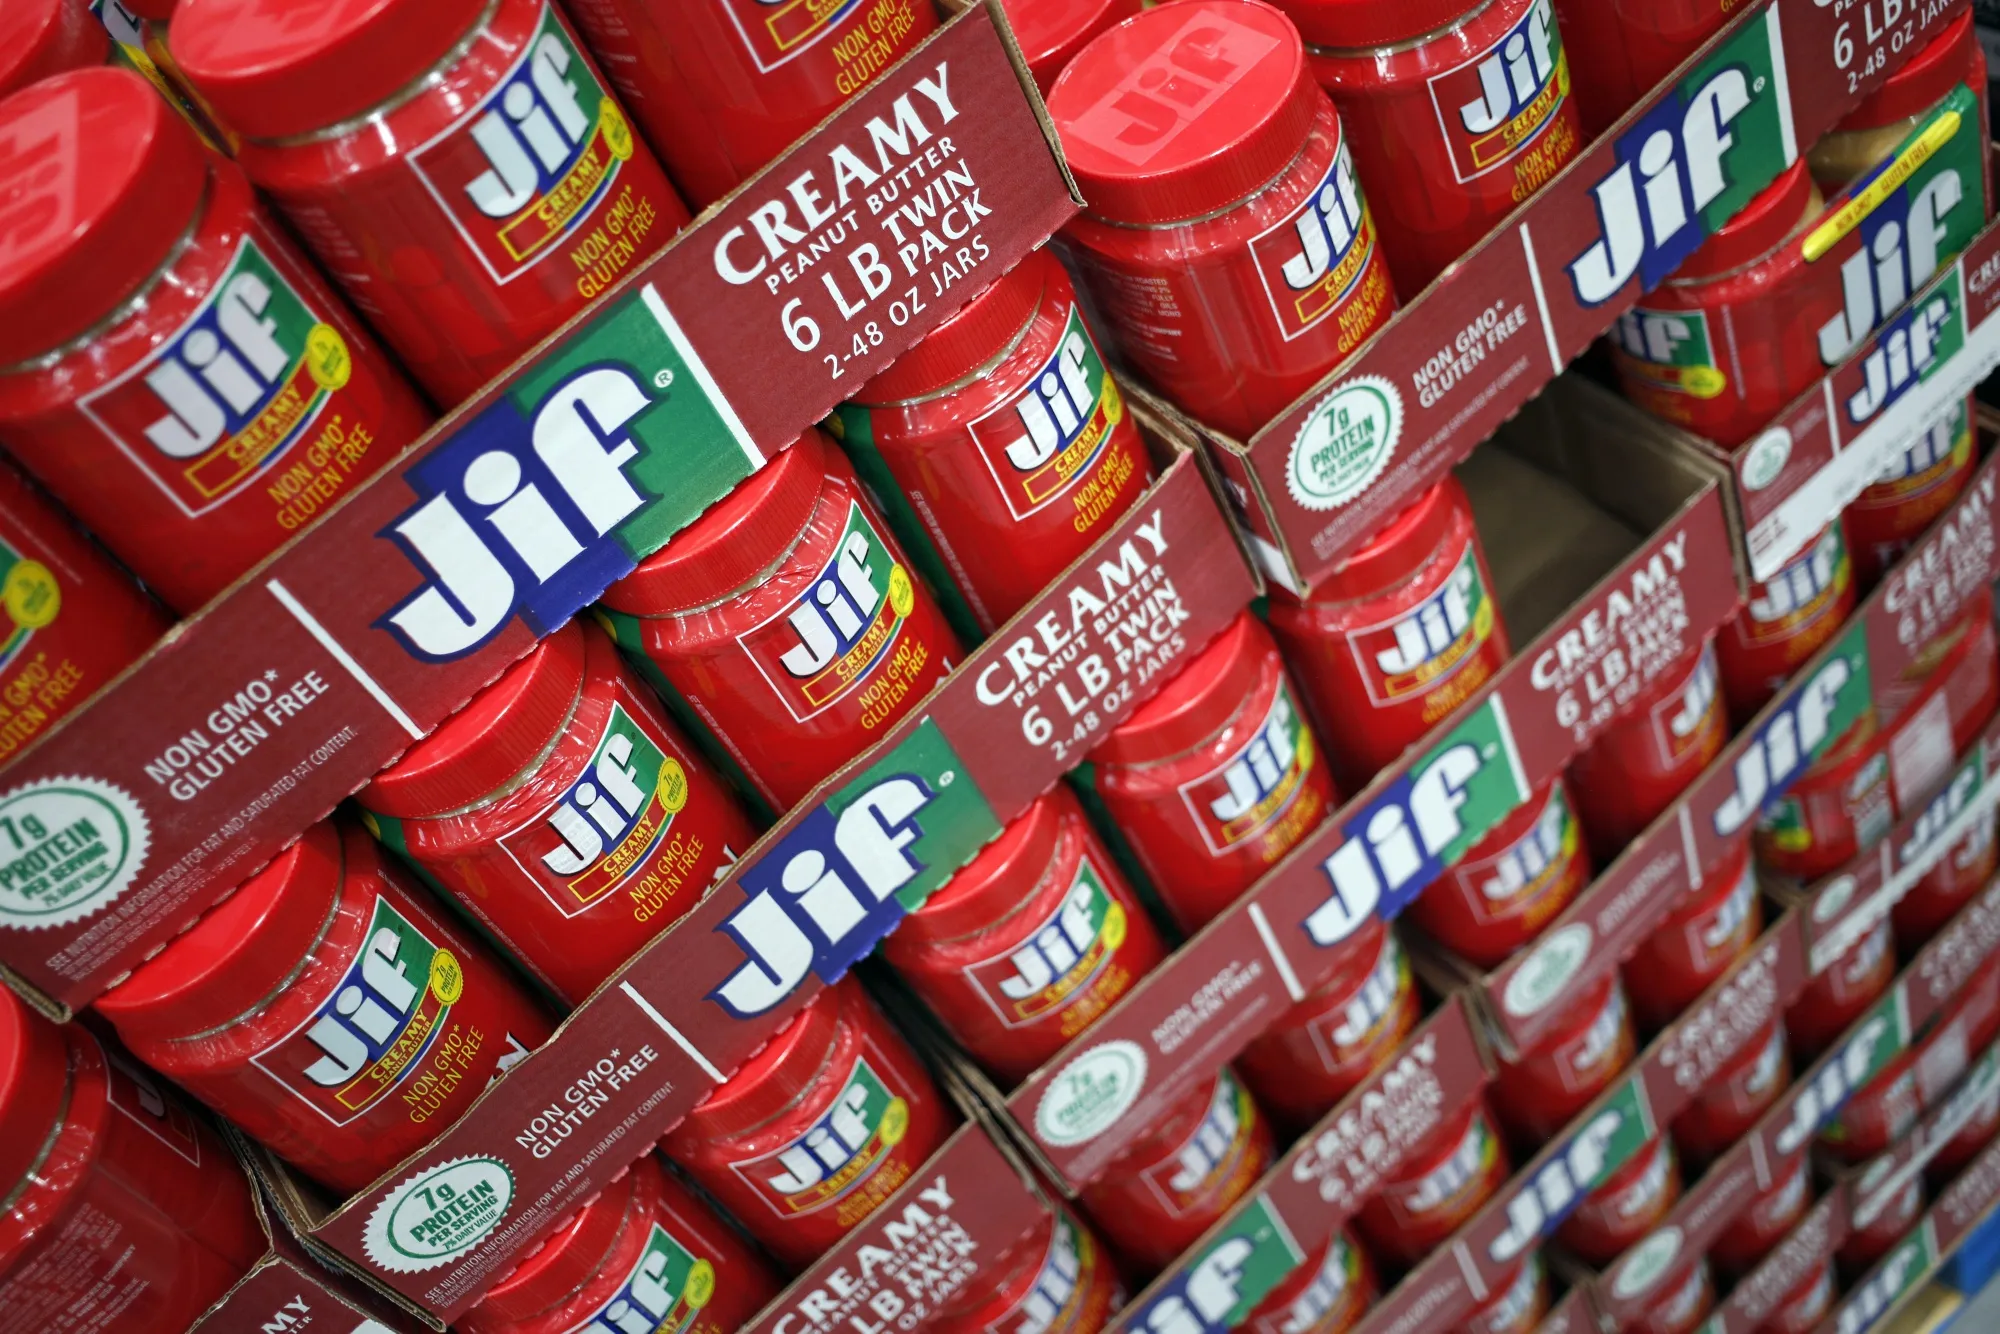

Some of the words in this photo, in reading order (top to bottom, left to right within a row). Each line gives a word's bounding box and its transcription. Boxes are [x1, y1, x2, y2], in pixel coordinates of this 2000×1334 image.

[832, 24, 870, 67] NON
[836, 35, 893, 95] GLUTEN
[887, 1, 915, 46] FREE
[1112, 27, 1238, 146] Jif
[1459, 0, 1553, 133] Jif
[1834, 21, 1854, 69] 6
[1847, 46, 1886, 94] 2-48
[1891, 19, 1915, 54] OZ
[464, 32, 590, 217] Jif
[1503, 87, 1553, 140] CREAMY
[537, 147, 600, 221] CREAMY
[714, 62, 960, 285] CREAMY
[1511, 157, 1558, 202] GLUTEN
[1514, 146, 1543, 182] NON
[1572, 68, 1751, 300] Jif
[570, 227, 610, 271] NON
[577, 235, 635, 298] GLUTEN
[628, 196, 656, 243] FREE
[765, 209, 861, 295] PEANUT
[866, 136, 956, 215] BUTTER
[781, 297, 821, 352] 6
[821, 242, 892, 321] LB
[881, 158, 976, 247] TWIN
[898, 188, 992, 278] PACK
[1282, 139, 1361, 290] Jif
[824, 321, 884, 380] 2-48
[889, 286, 926, 327] OZ
[930, 234, 991, 297] JARS
[1818, 169, 1962, 365] Jif
[1338, 296, 1363, 331] NON
[1419, 343, 1486, 408] GLUTEN
[1487, 302, 1528, 352] FREE
[143, 272, 290, 458] Jif
[1004, 331, 1094, 470] Jif
[1413, 345, 1453, 391] NON
[1850, 297, 1948, 423] Jif
[227, 383, 300, 460] CREAMY
[1055, 419, 1098, 472] CREAMY
[1310, 414, 1375, 473] PROTEIN
[1323, 406, 1350, 437] 7g
[267, 462, 313, 505] NON
[276, 465, 343, 529] GLUTEN
[335, 422, 373, 473] FREE
[388, 368, 652, 656] Jif
[1073, 484, 1117, 532] GLUTEN
[1112, 451, 1134, 492] FREE
[1073, 478, 1100, 512] NON
[779, 529, 880, 678] Jif
[836, 615, 887, 676] CREAMY
[975, 508, 1169, 706] CREAMY
[1012, 632, 1089, 708] PEANUT
[1093, 564, 1165, 636] BUTTER
[1115, 597, 1191, 675] PACK
[1376, 565, 1474, 674] Jif
[1531, 528, 1686, 690] CREAMY
[37, 658, 85, 710] FREE
[858, 675, 890, 710] NON
[861, 679, 909, 730] GLUTEN
[904, 641, 928, 683] FREE
[1021, 704, 1053, 746] 6
[1055, 653, 1112, 717] LB
[1103, 577, 1178, 655] TWIN
[1050, 711, 1100, 762] 2-48
[1102, 679, 1134, 713] OZ
[1136, 631, 1187, 685] JARS
[1556, 688, 1581, 728] 6
[1584, 648, 1627, 704] LB
[144, 727, 212, 787] NON
[169, 719, 270, 802] GLUTEN
[264, 670, 330, 728] FREE
[1210, 697, 1295, 821] Jif
[1713, 658, 1849, 836] Jif
[0, 813, 48, 850] 7g
[65, 913, 121, 956] NUTRITION
[116, 862, 188, 917] INFORMATION
[181, 847, 208, 869] FOR
[201, 832, 223, 853] FAT
[219, 817, 245, 839] AND
[240, 775, 297, 822] SATURATED
[292, 760, 314, 780] FAT
[310, 725, 358, 766] CONTENT.
[541, 733, 646, 877] Jif
[603, 814, 654, 873] CREAMY
[1305, 745, 1480, 945] Jif
[0, 816, 101, 891] PROTEIN
[19, 875, 52, 900] PER
[609, 852, 637, 878] PEANUT
[635, 826, 656, 854] BUTTER
[629, 871, 662, 904] NON
[634, 876, 683, 922] GLUTEN
[676, 834, 704, 876] FREE
[717, 778, 930, 1013] Jif
[441, 964, 455, 995] PROTEIN
[999, 881, 1095, 999] Jif
[302, 927, 418, 1087] Jif
[371, 1008, 428, 1080] CREAMY
[379, 1053, 409, 1084] PEANUT
[408, 1020, 432, 1053] BUTTER
[402, 1070, 439, 1106] NON
[410, 1067, 463, 1123] GLUTEN
[455, 1025, 484, 1070] FREE
[532, 1089, 609, 1159] GLUTEN
[607, 1044, 659, 1091] FREE
[1778, 1016, 1886, 1153] Jif
[515, 1103, 565, 1149] NON
[767, 1082, 872, 1195] Jif
[409, 1179, 495, 1243] PROTEIN
[414, 1182, 456, 1211] 7g
[424, 1283, 443, 1301] SEE
[443, 1251, 486, 1290] NUTRITION
[484, 1207, 537, 1255] INFORMATION
[534, 1192, 554, 1212] FOR
[551, 1178, 568, 1195] FAT
[566, 1163, 585, 1184] AND
[581, 1124, 627, 1167] SATURATED
[622, 1113, 640, 1129] FAT
[637, 1081, 676, 1116] CONTENT.
[427, 1230, 452, 1247] PER
[451, 1194, 499, 1231] SERVING
[455, 1225, 477, 1242] DAILY
[473, 1209, 498, 1228] VALUE
[1490, 1109, 1623, 1263] Jif
[771, 1175, 955, 1334] CREAMY
[849, 1289, 905, 1334] LB
